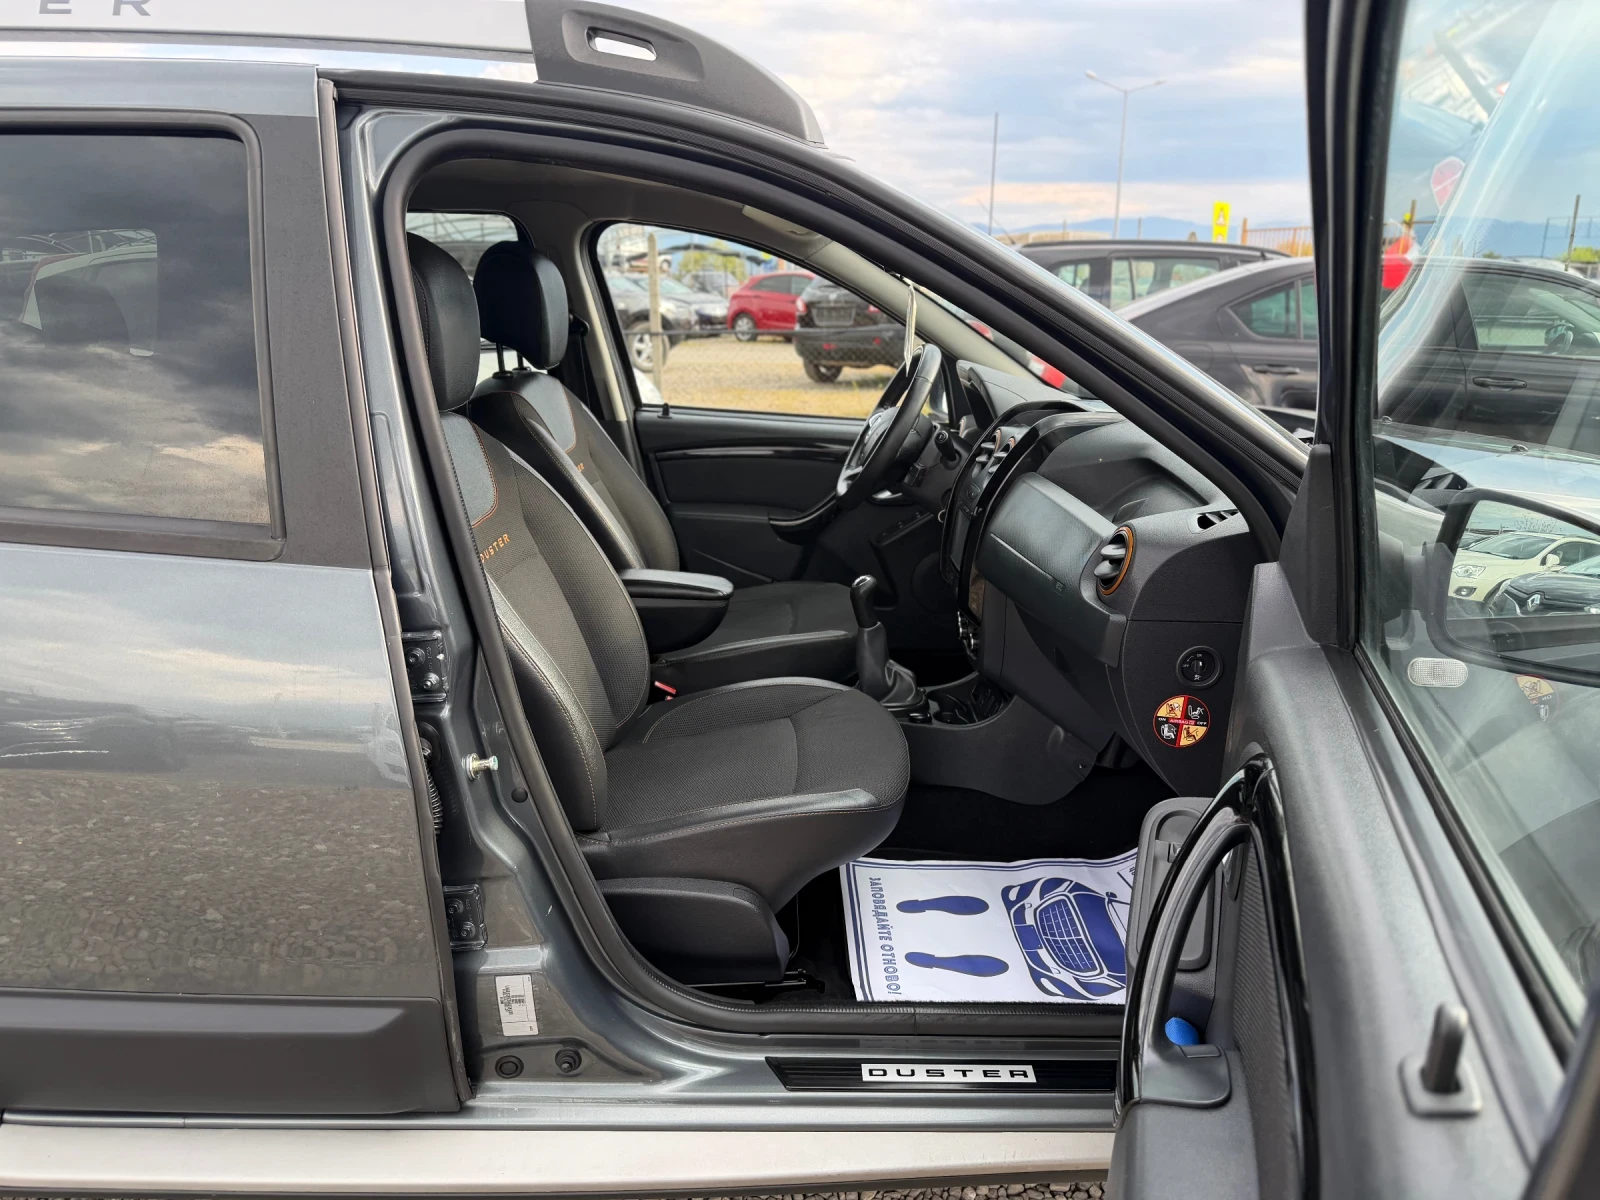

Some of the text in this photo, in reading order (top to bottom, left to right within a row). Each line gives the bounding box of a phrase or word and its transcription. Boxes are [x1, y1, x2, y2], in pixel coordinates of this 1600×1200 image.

[868, 877, 902, 995] ЗАПОВЯДАЙТЕ ОТНОВО!
[868, 1068, 1029, 1079] DUSTER
